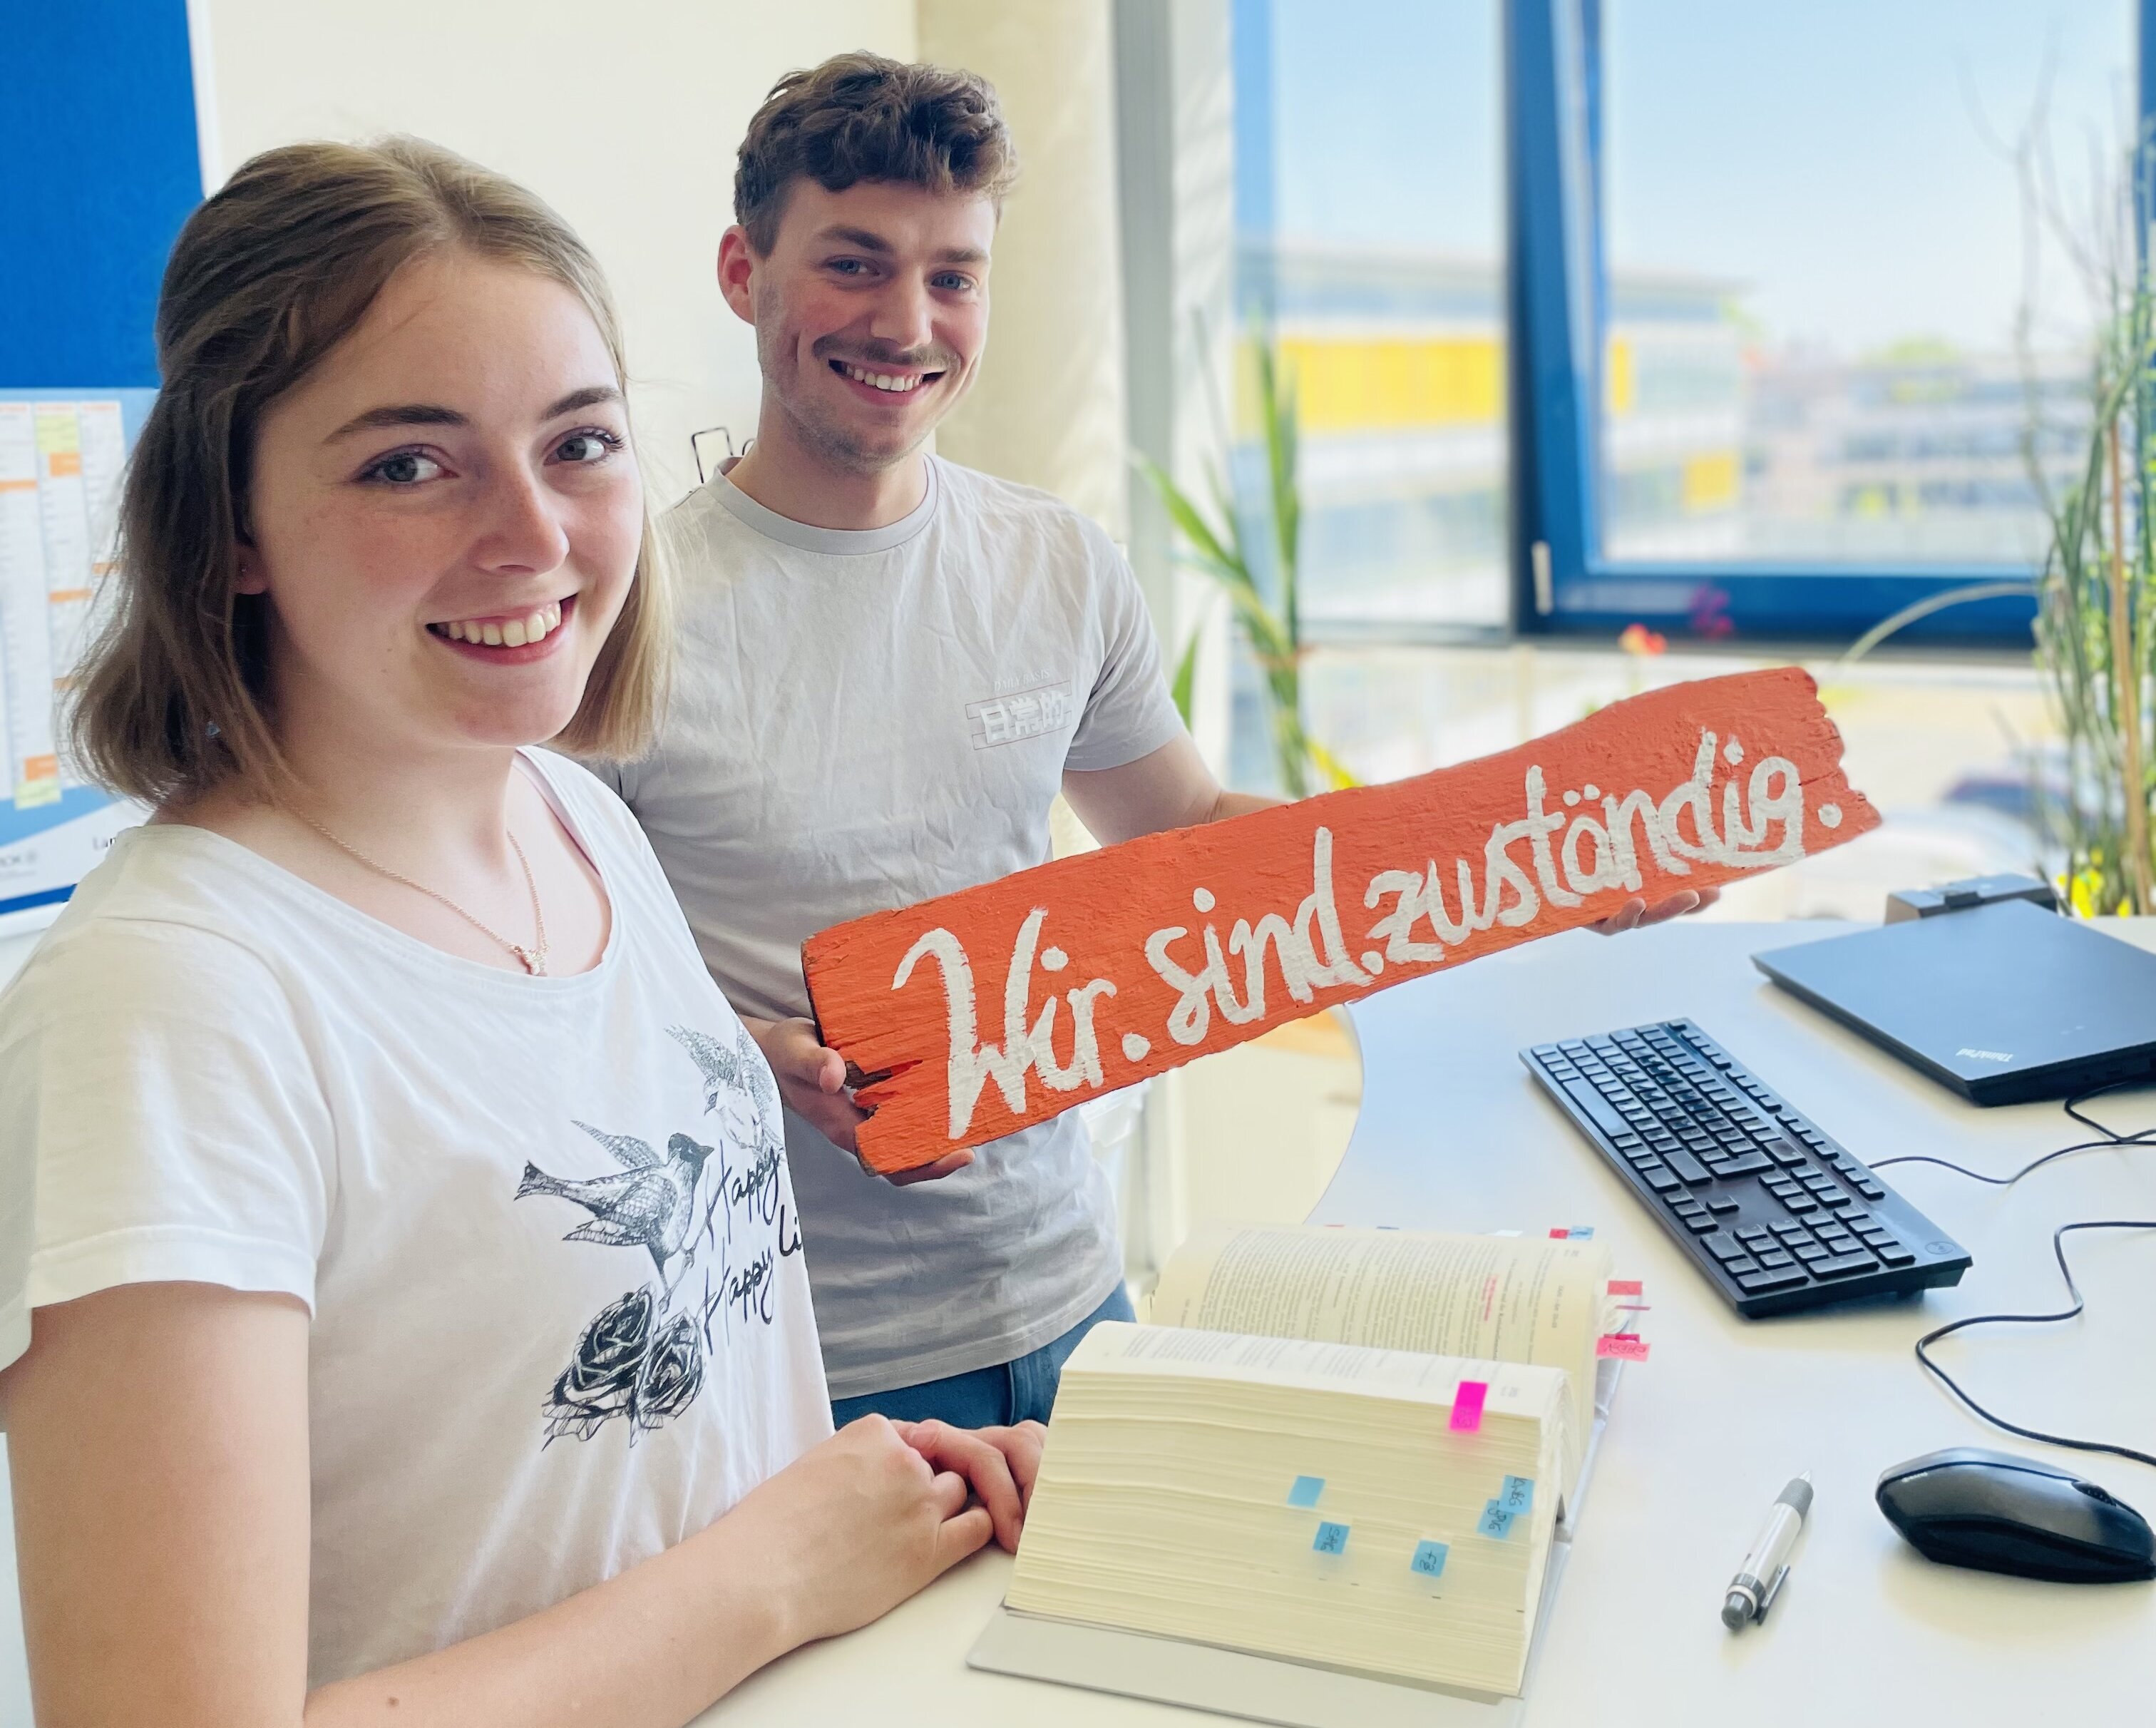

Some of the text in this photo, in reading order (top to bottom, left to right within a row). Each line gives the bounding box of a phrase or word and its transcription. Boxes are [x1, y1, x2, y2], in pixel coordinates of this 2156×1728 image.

[994, 675, 1021, 691] DAILY
[980, 690, 1068, 745] 日常的
[1955, 1048, 2014, 1062] ThinkPad
[704, 1139, 780, 1252] Happy
[703, 1236, 774, 1356] Happy
